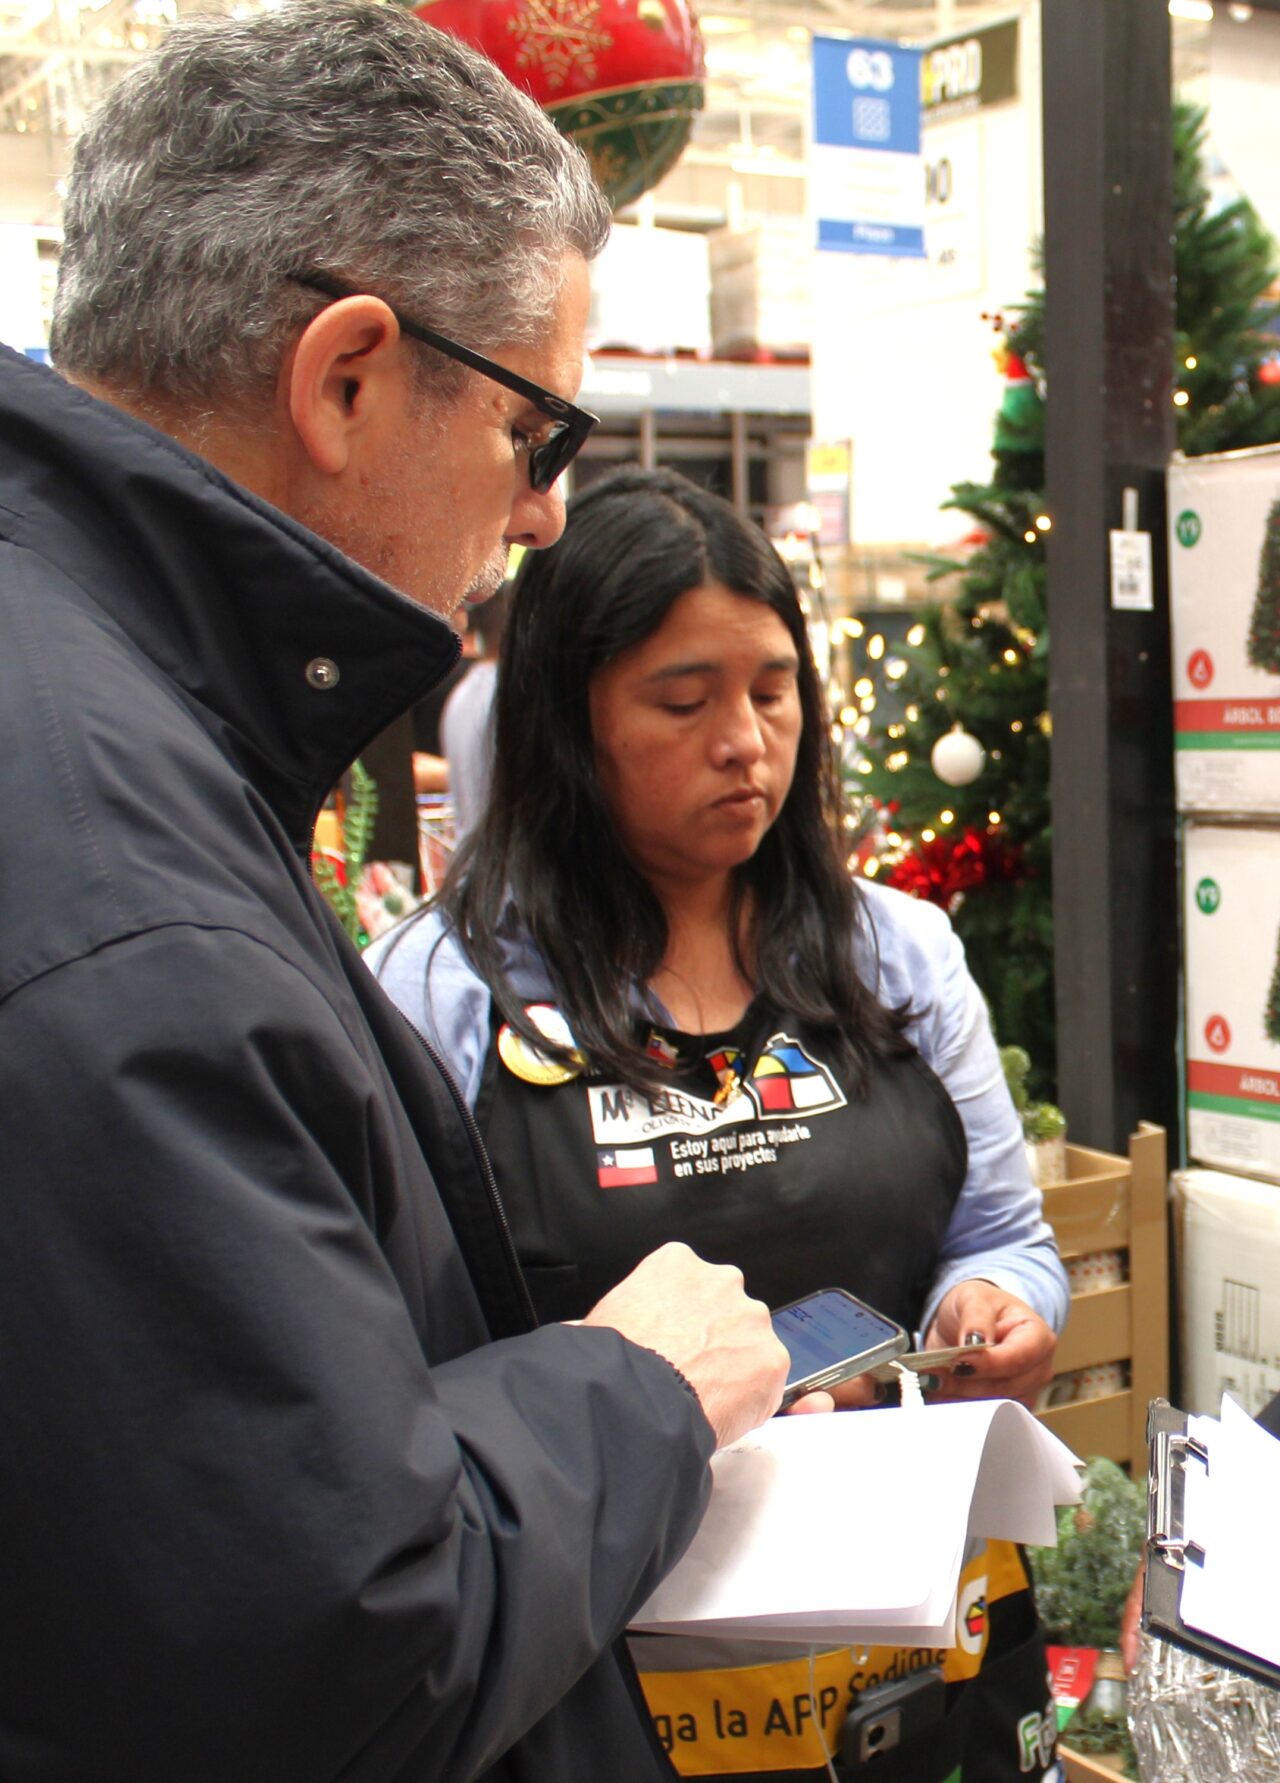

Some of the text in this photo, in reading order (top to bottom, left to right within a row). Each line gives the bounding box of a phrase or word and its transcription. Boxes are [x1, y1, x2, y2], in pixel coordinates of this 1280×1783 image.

[846, 48, 895, 91] 63
[1222, 703, 1263, 725] ÁRBOL
[670, 1140, 708, 1160] Estoy
[711, 1131, 737, 1157] aquí
[738, 1131, 766, 1151] para
[673, 1146, 778, 1178] en sus proyectos
[713, 1699, 748, 1740] la
[763, 1686, 838, 1738] APP
